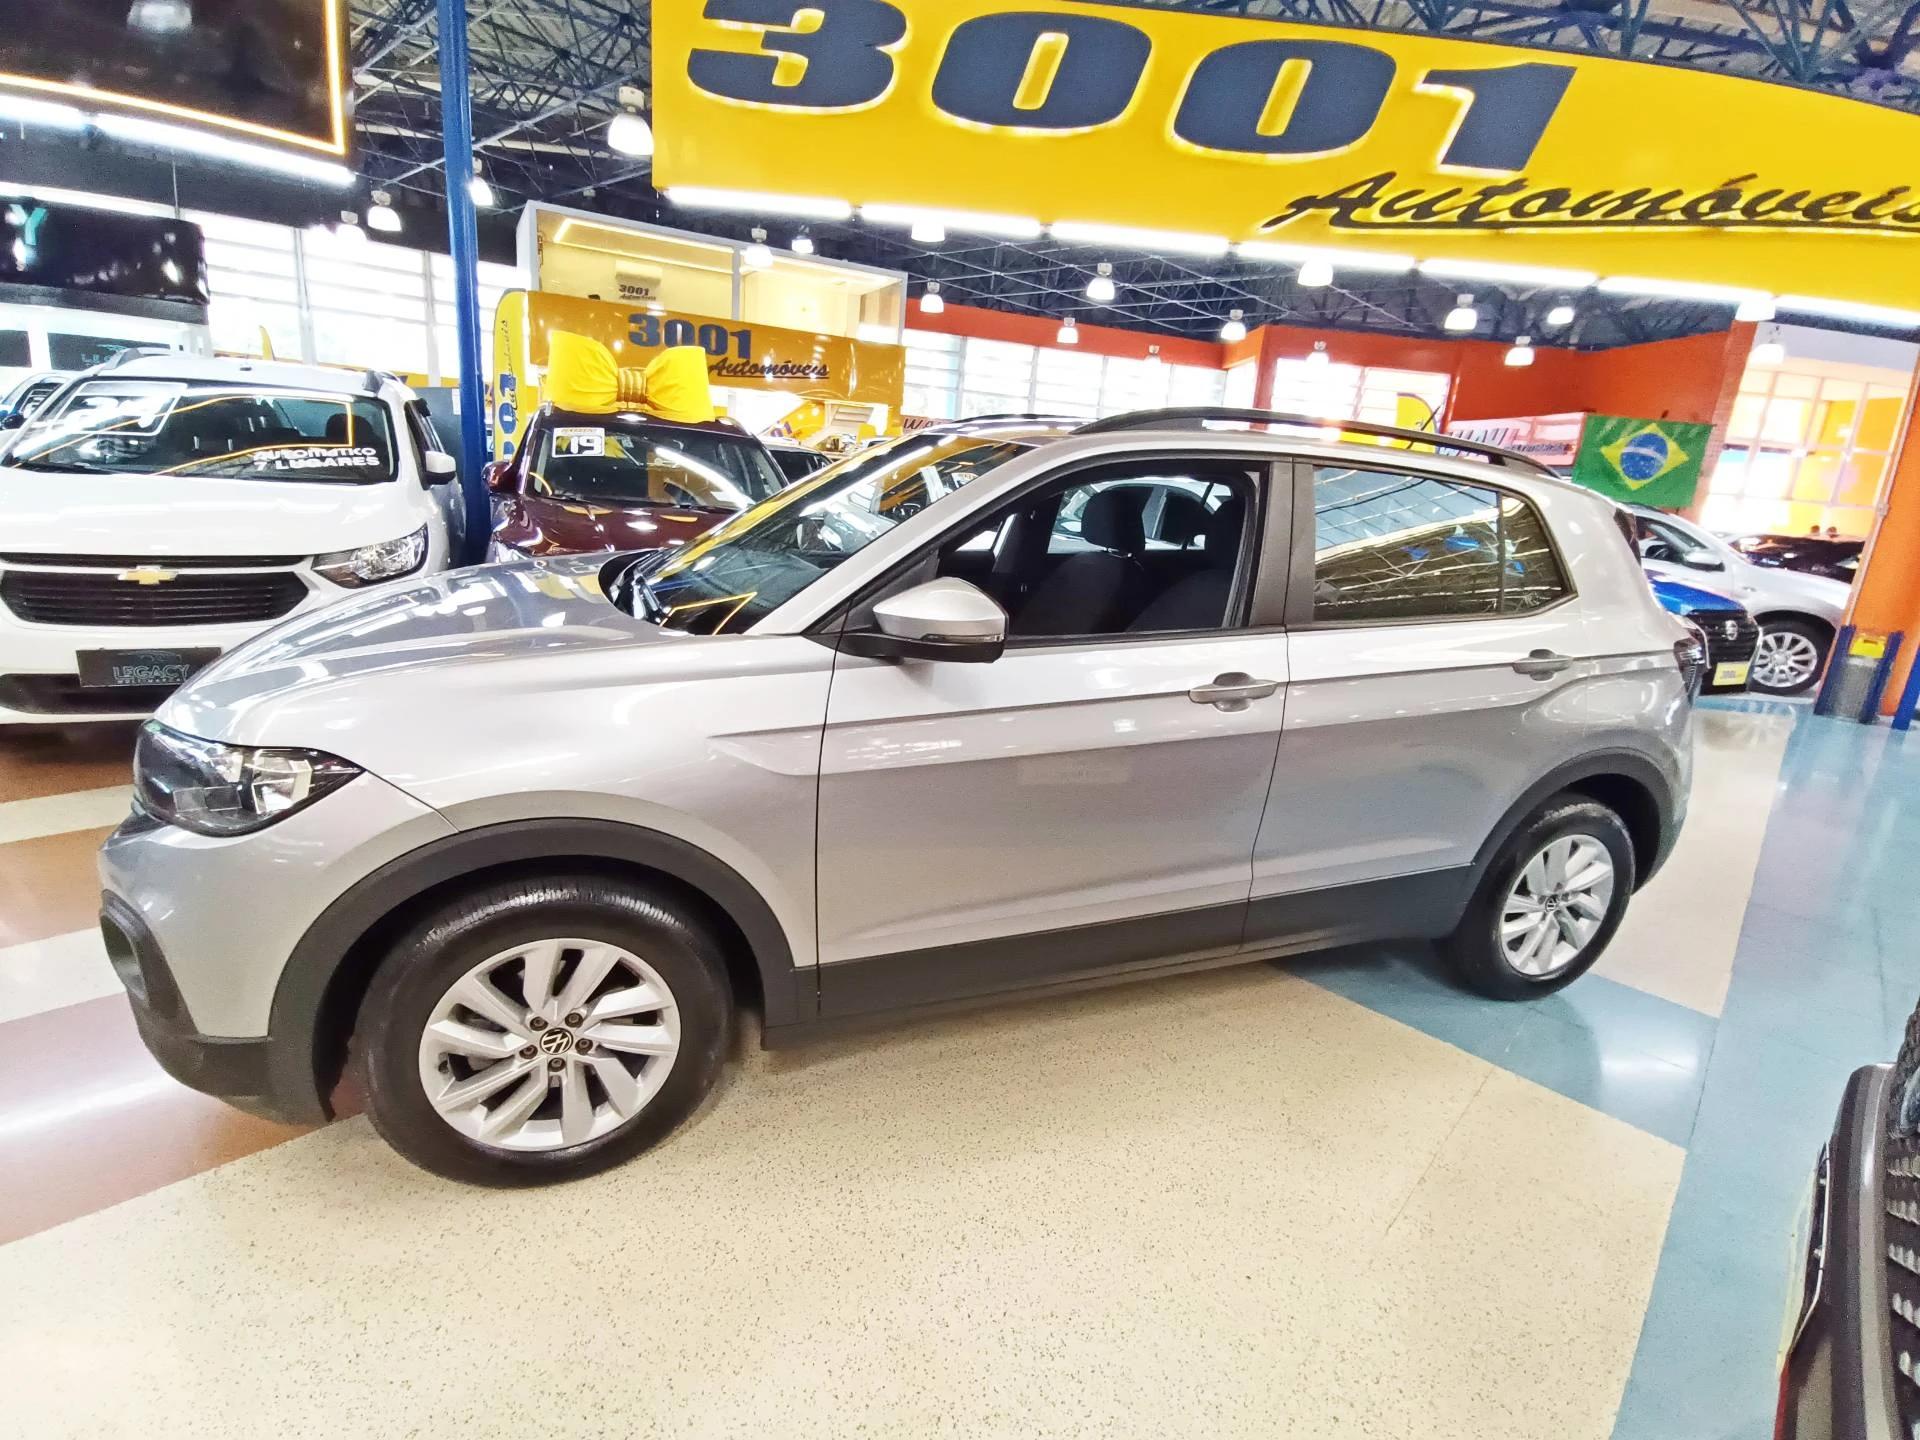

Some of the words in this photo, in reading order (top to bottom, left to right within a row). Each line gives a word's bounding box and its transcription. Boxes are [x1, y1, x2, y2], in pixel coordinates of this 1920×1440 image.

[687, 0, 1577, 171] 3001
[619, 284, 650, 296] 3001
[629, 313, 752, 359] 3001
[708, 357, 830, 379] Automóveis
[254, 461, 267, 471] 7
[275, 457, 381, 470] LUGARES
[112, 664, 190, 681] LEGACY
